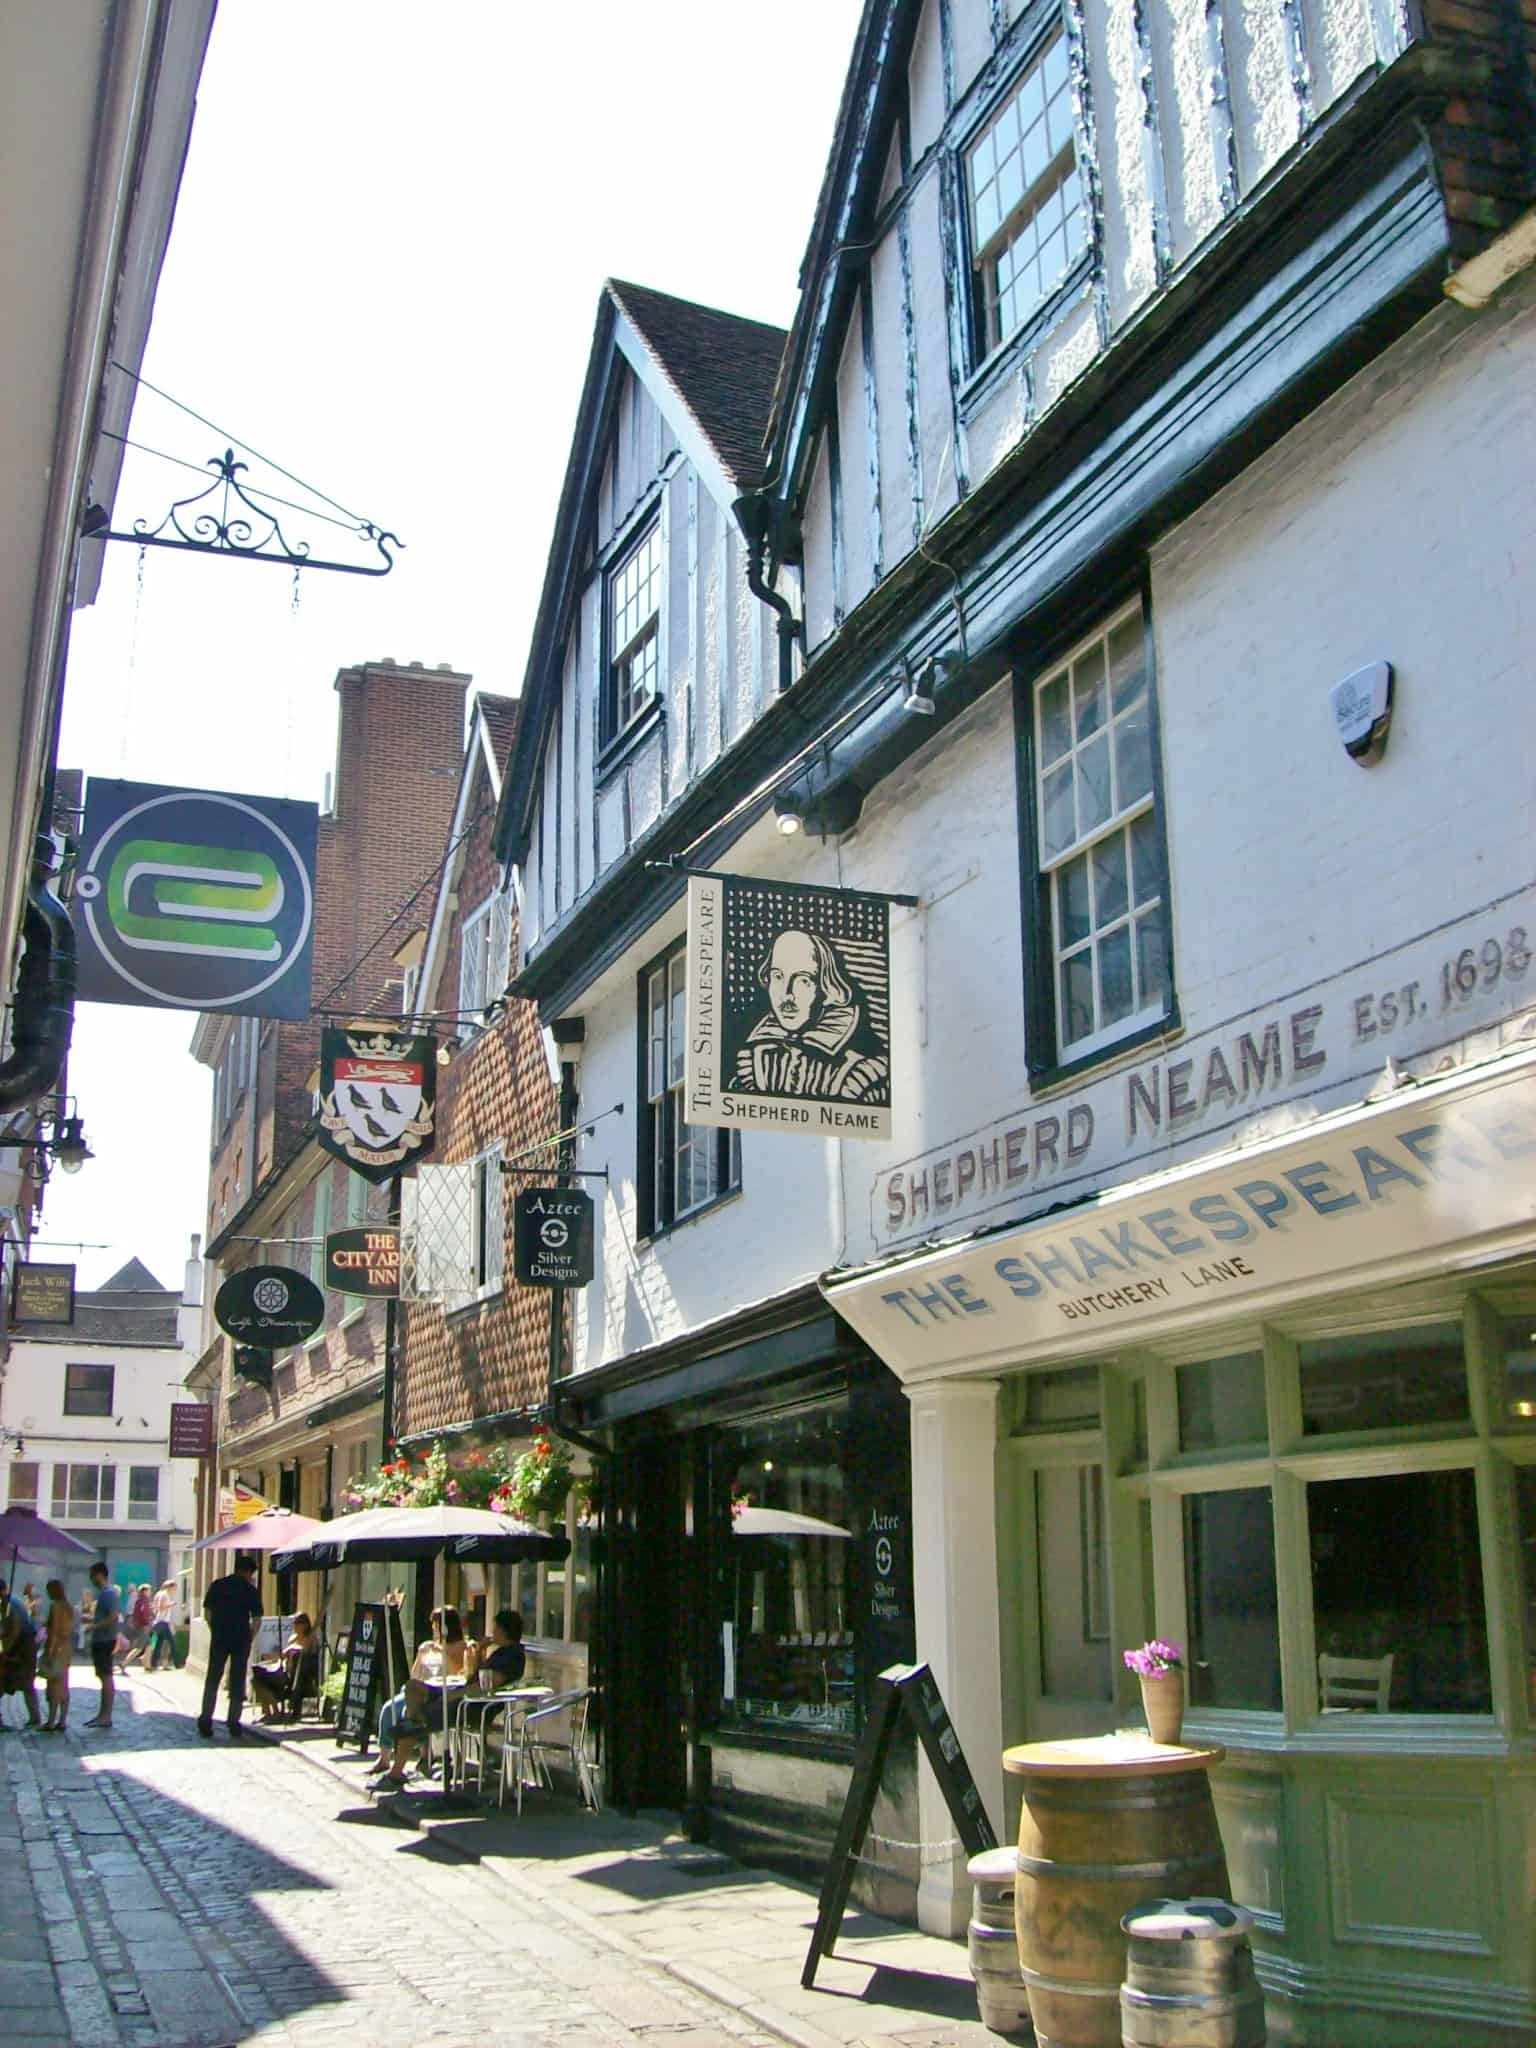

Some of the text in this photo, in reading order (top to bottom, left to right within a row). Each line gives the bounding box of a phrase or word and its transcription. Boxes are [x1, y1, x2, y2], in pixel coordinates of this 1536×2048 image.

[691, 889, 715, 1112] THE SHAKESPEARE
[885, 926, 1533, 1228] SHEPHERD NEAME EST. 1698
[721, 1096, 880, 1129] SHEPHERD NEAME
[525, 1196, 583, 1215] Aztec
[364, 1233, 397, 1250] THE
[332, 1250, 375, 1268] CITY
[537, 1251, 573, 1265] Silver
[368, 1268, 397, 1286] INN
[530, 1263, 579, 1281] Designs
[1058, 1256, 1255, 1320] BUTCHERY LANE
[880, 1272, 990, 1326] THE
